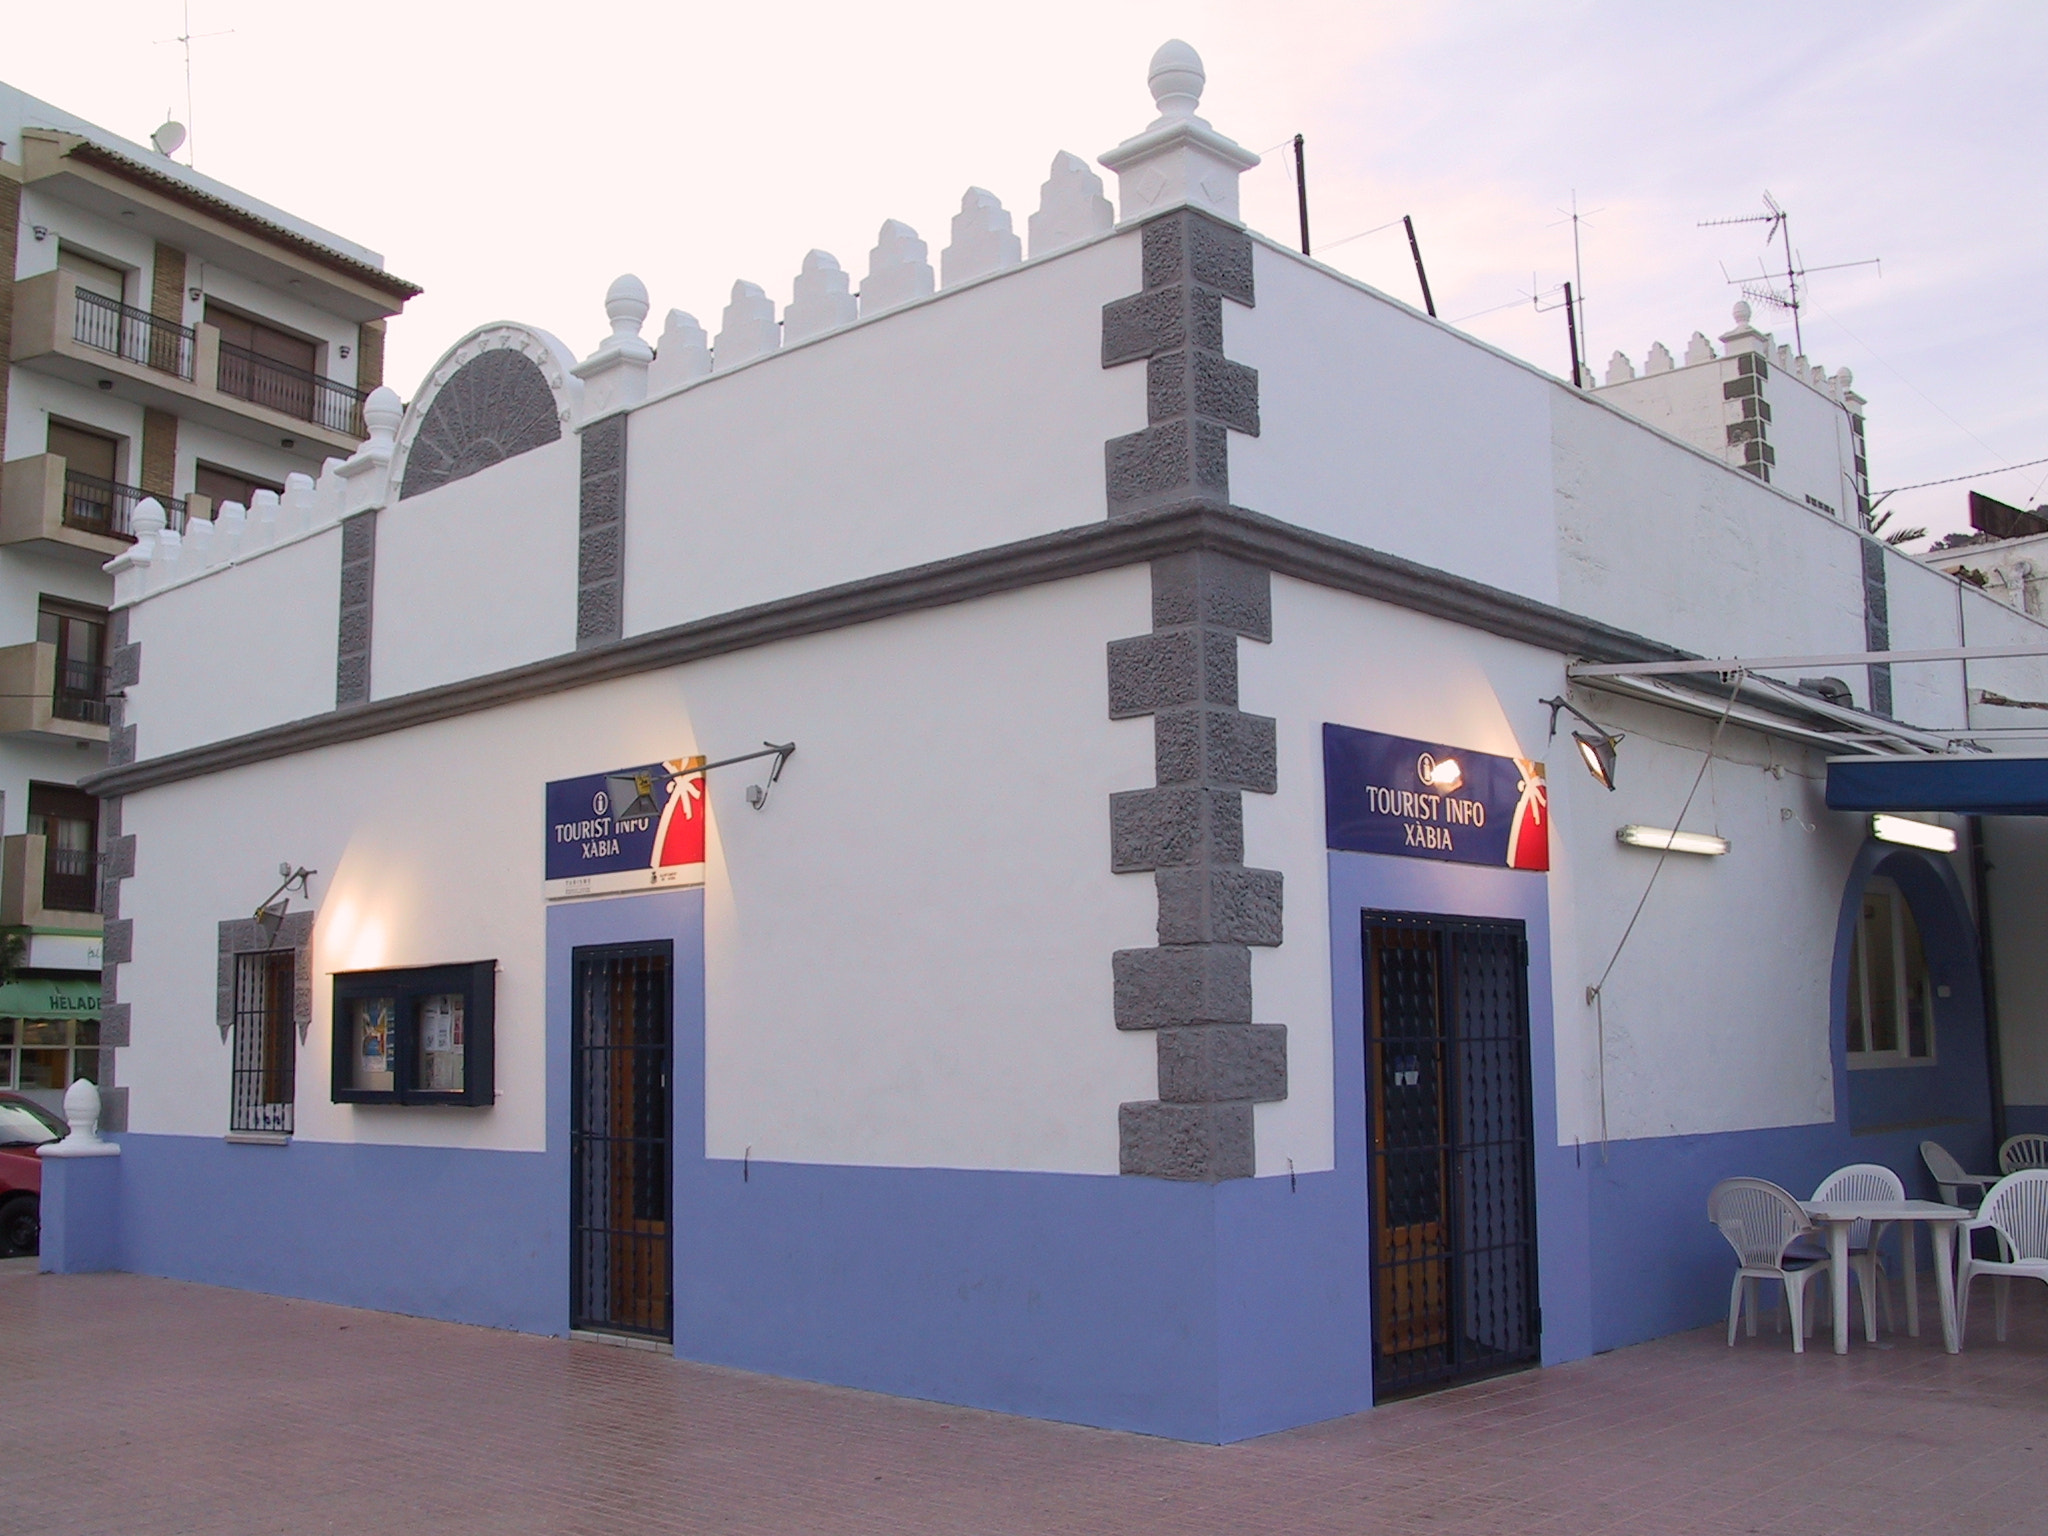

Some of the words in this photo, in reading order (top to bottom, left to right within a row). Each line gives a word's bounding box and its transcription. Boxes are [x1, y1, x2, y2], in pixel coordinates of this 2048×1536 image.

[1366, 785, 1440, 821] TOURIST
[1446, 798, 1485, 828] INFO
[555, 817, 611, 843] TOURIST
[1404, 820, 1453, 851] XÀBIA
[582, 838, 620, 859] XÀBIA
